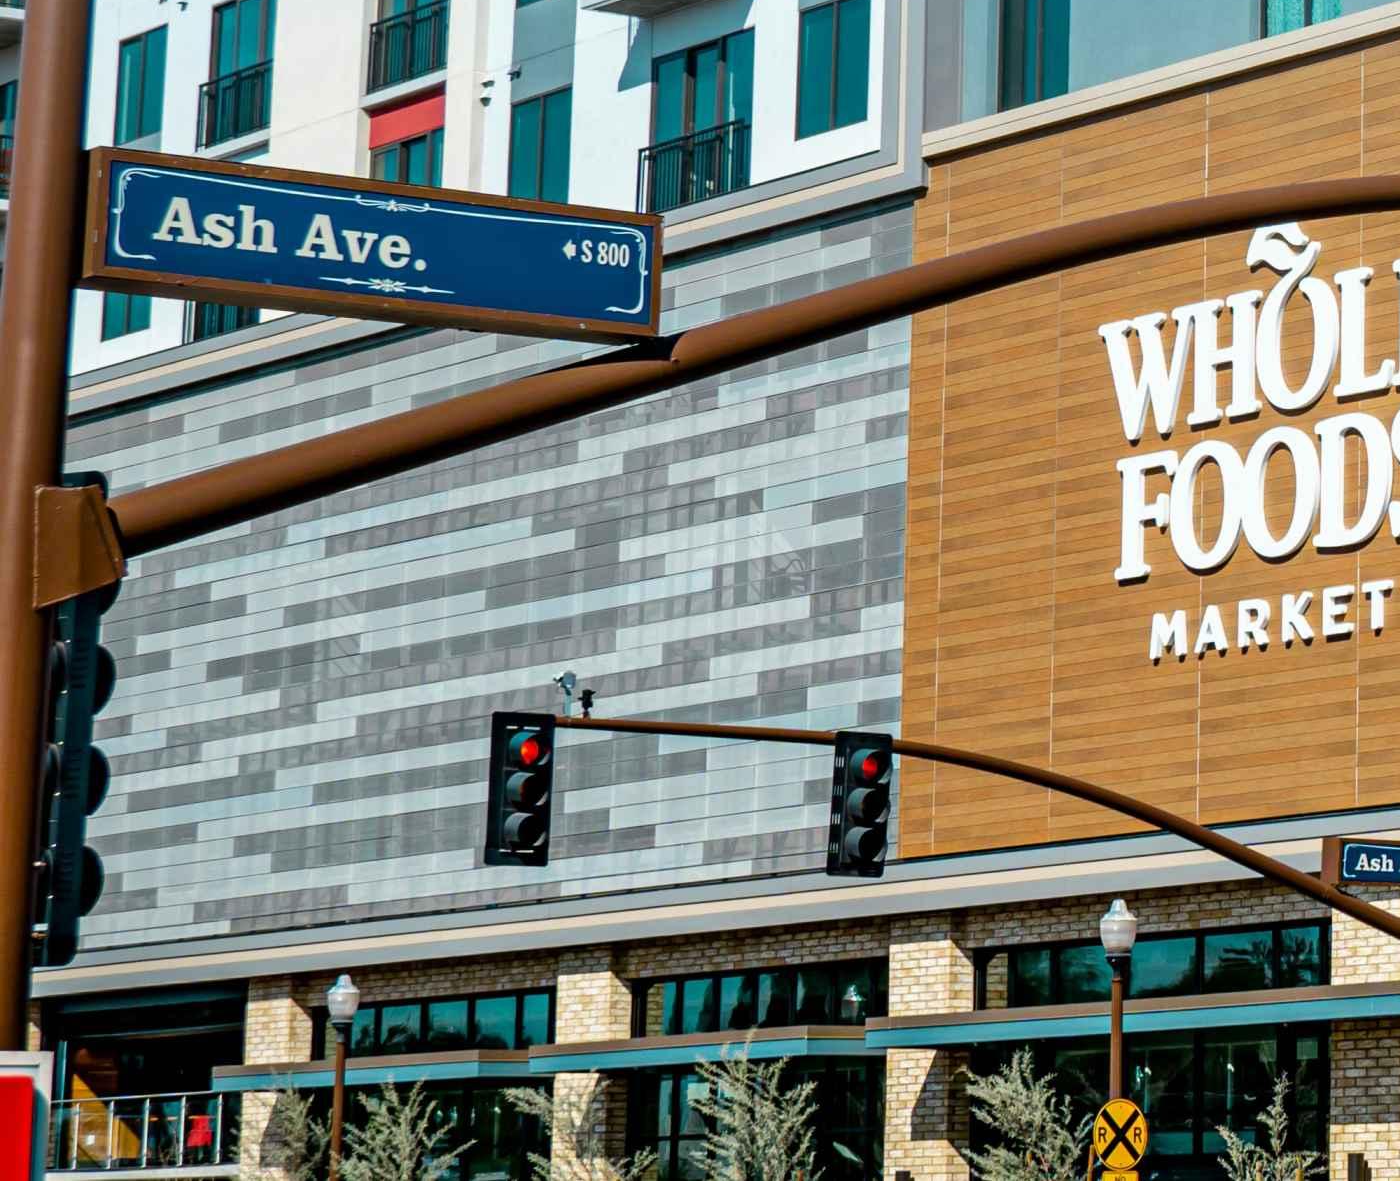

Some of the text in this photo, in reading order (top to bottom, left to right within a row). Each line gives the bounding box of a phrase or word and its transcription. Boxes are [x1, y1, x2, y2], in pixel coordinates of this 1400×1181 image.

[153, 197, 428, 271] Ash Ave.
[581, 240, 630, 268] S 800
[1149, 579, 1394, 660] MARKET
[1355, 853, 1394, 872] Ash
[1098, 1127, 1142, 1143] R R
